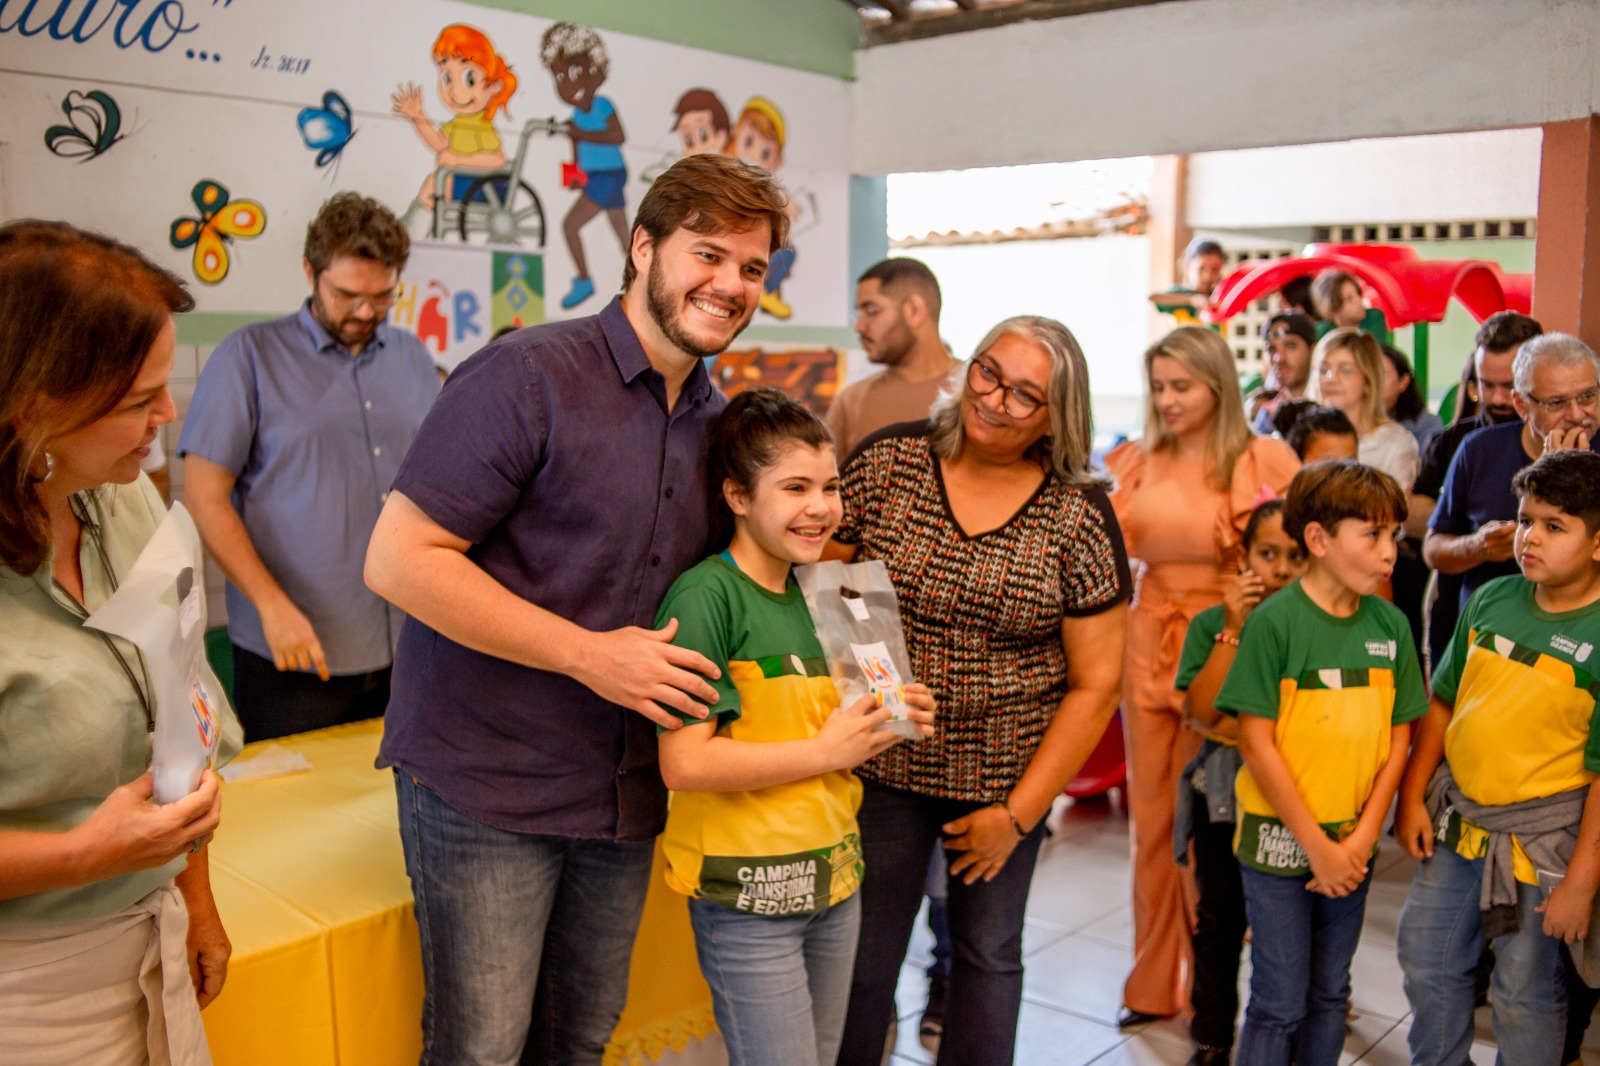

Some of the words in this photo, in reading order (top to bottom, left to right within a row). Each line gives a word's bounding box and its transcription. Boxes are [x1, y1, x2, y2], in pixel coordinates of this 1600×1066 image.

[737, 859, 817, 883] CAMPINA
[740, 875, 815, 900] TRANSFORMA
[735, 893, 751, 910] E
[752, 894, 815, 916] EDUCA
